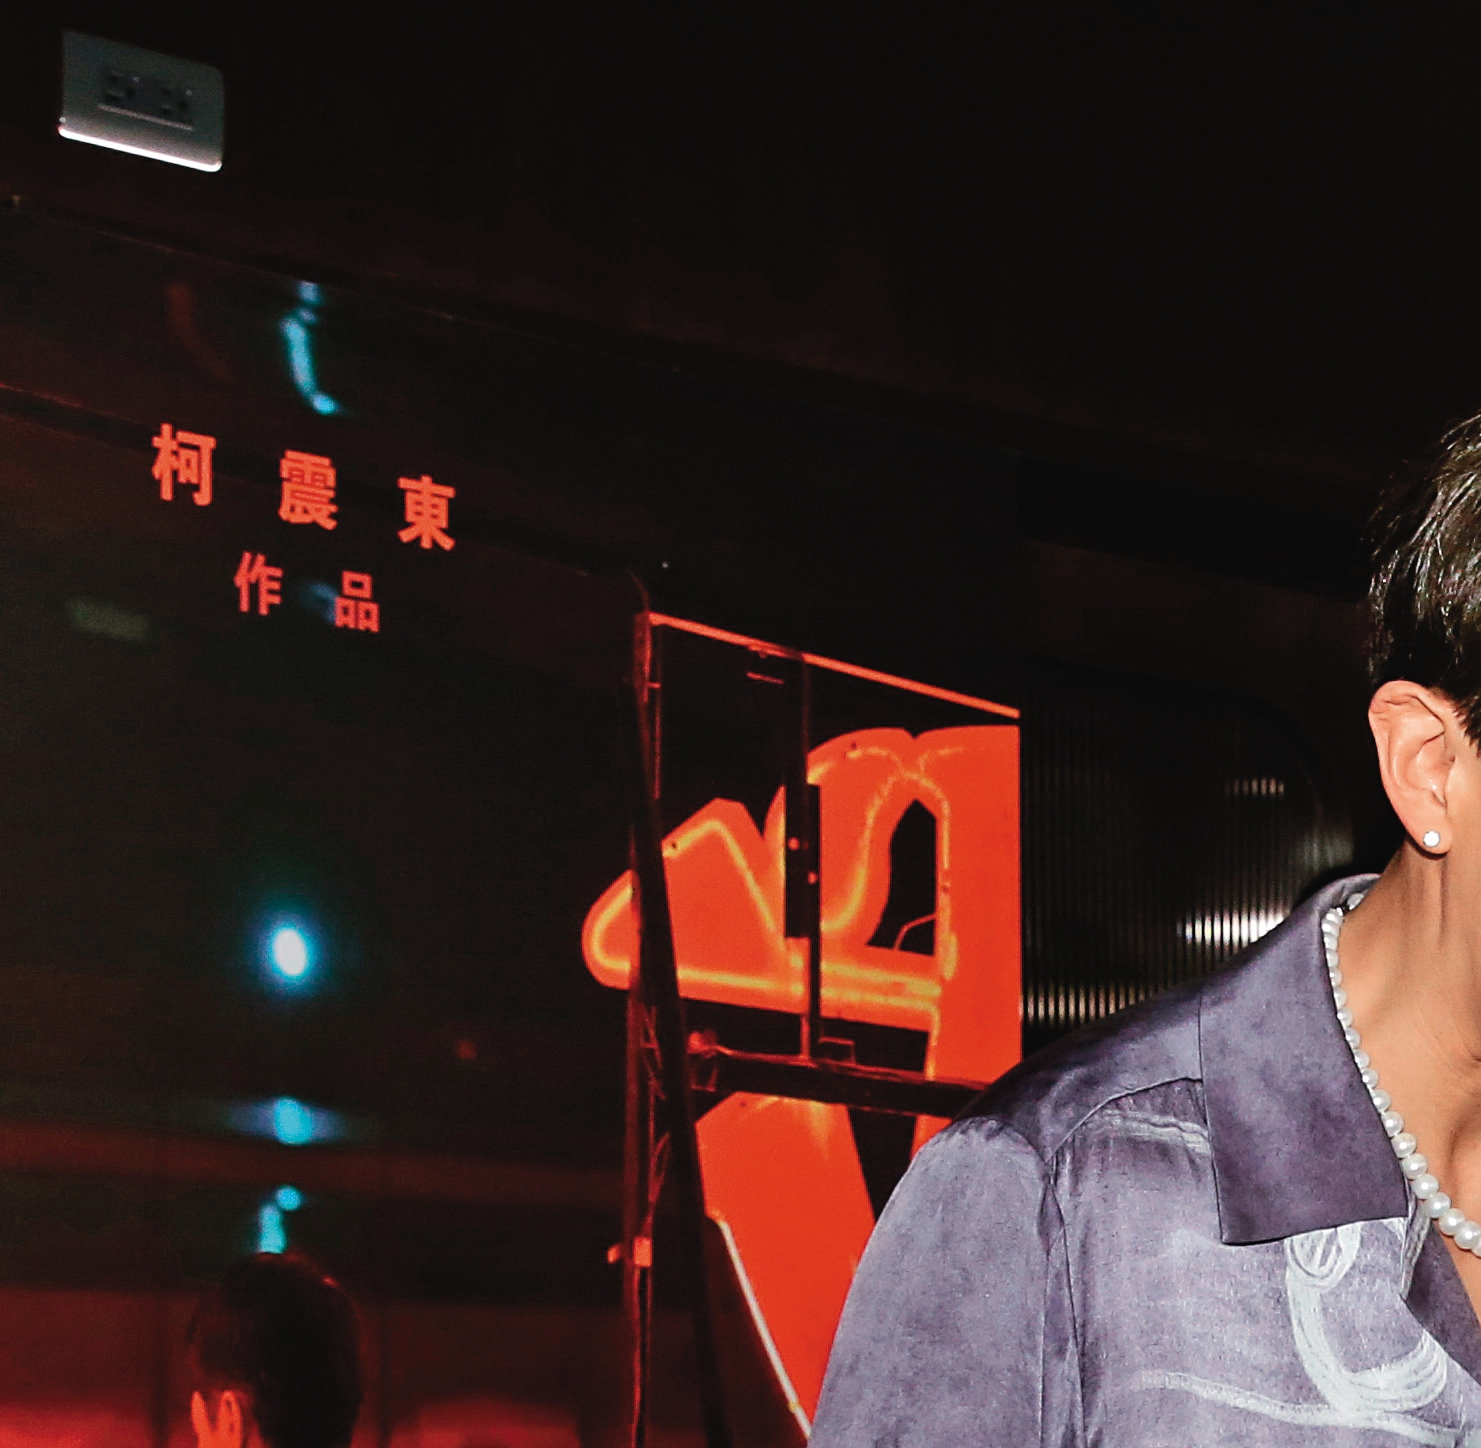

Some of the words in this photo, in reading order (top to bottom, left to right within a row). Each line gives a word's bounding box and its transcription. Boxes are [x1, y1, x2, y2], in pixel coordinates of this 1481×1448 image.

[151, 422, 456, 551] 柯震東
[234, 551, 380, 633] 作品
